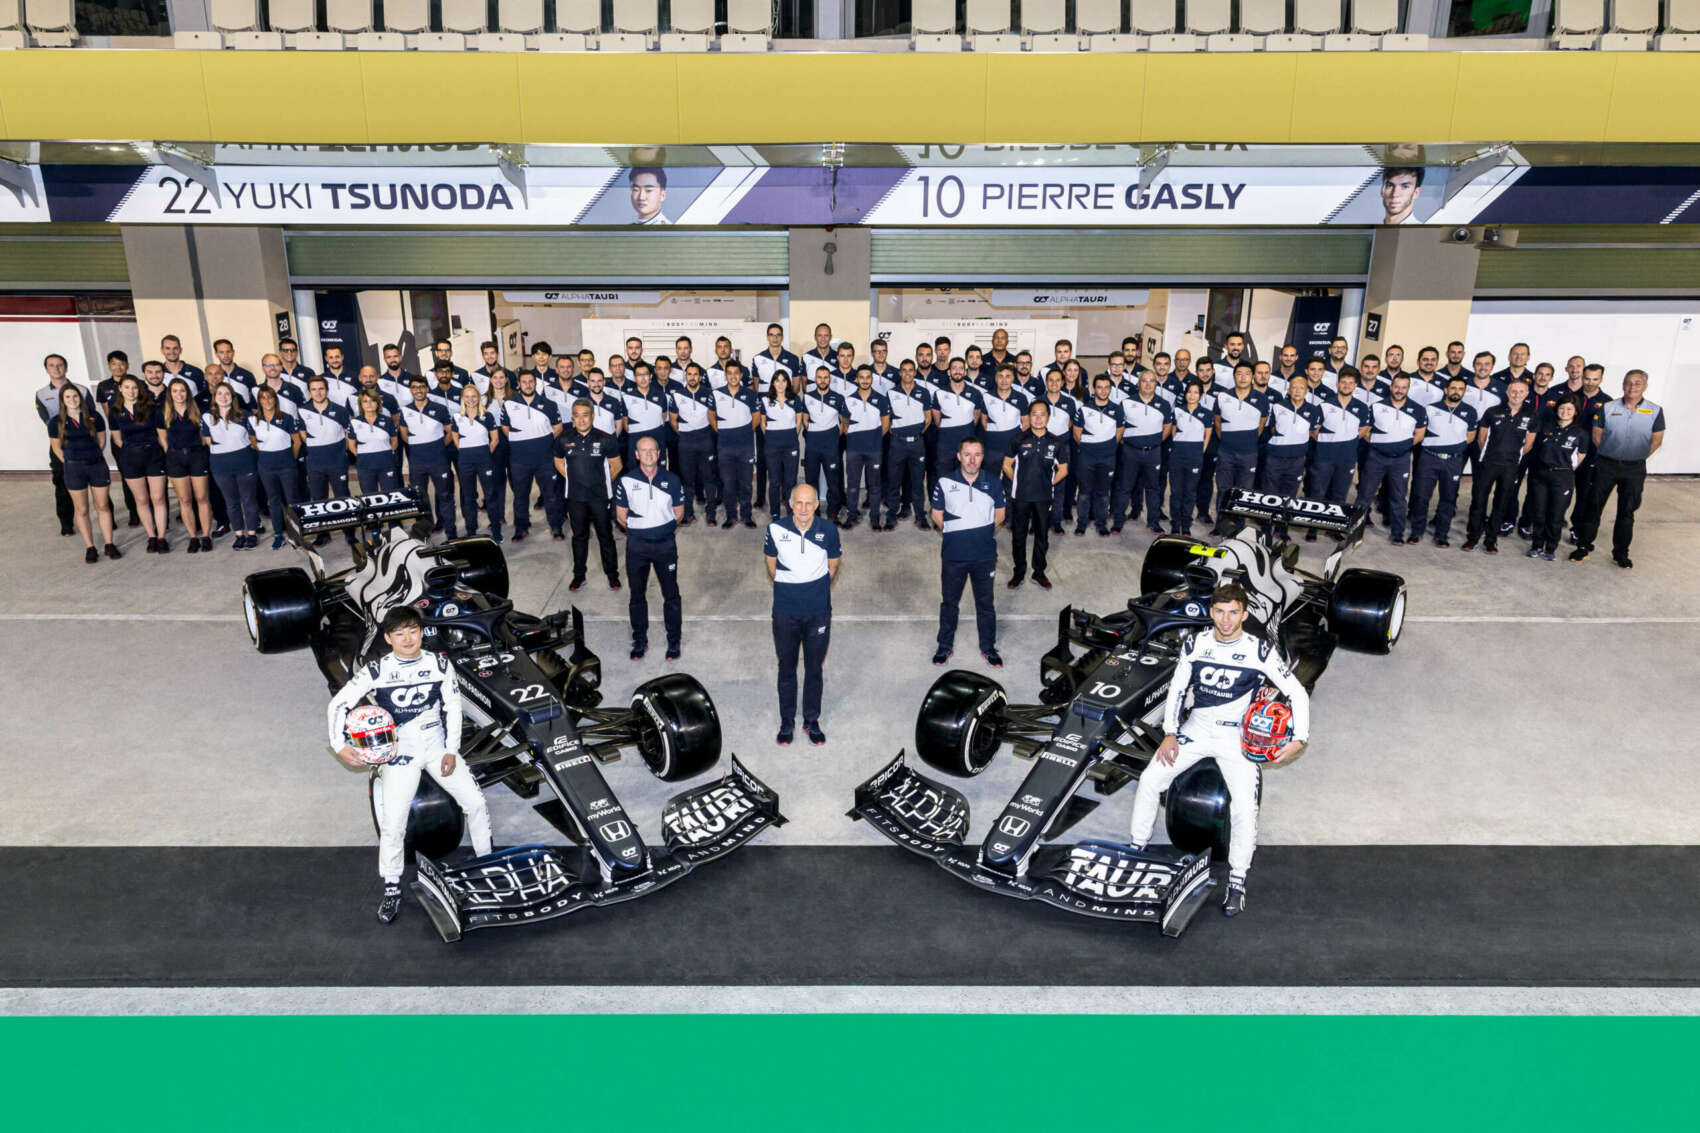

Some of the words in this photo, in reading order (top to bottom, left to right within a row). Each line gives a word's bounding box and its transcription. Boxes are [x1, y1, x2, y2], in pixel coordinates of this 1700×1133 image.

[158, 176, 212, 215] 22
[223, 182, 313, 210] YUKI
[321, 183, 514, 210] TSUNODA
[917, 175, 965, 218] 10
[982, 183, 1115, 210] PIERRE
[1124, 183, 1247, 210] GASLY
[300, 491, 412, 516] HONDA
[1238, 491, 1347, 517] HONDA
[510, 684, 550, 703] 22
[1089, 681, 1121, 698] 10
[1064, 848, 1172, 899] TAUR
